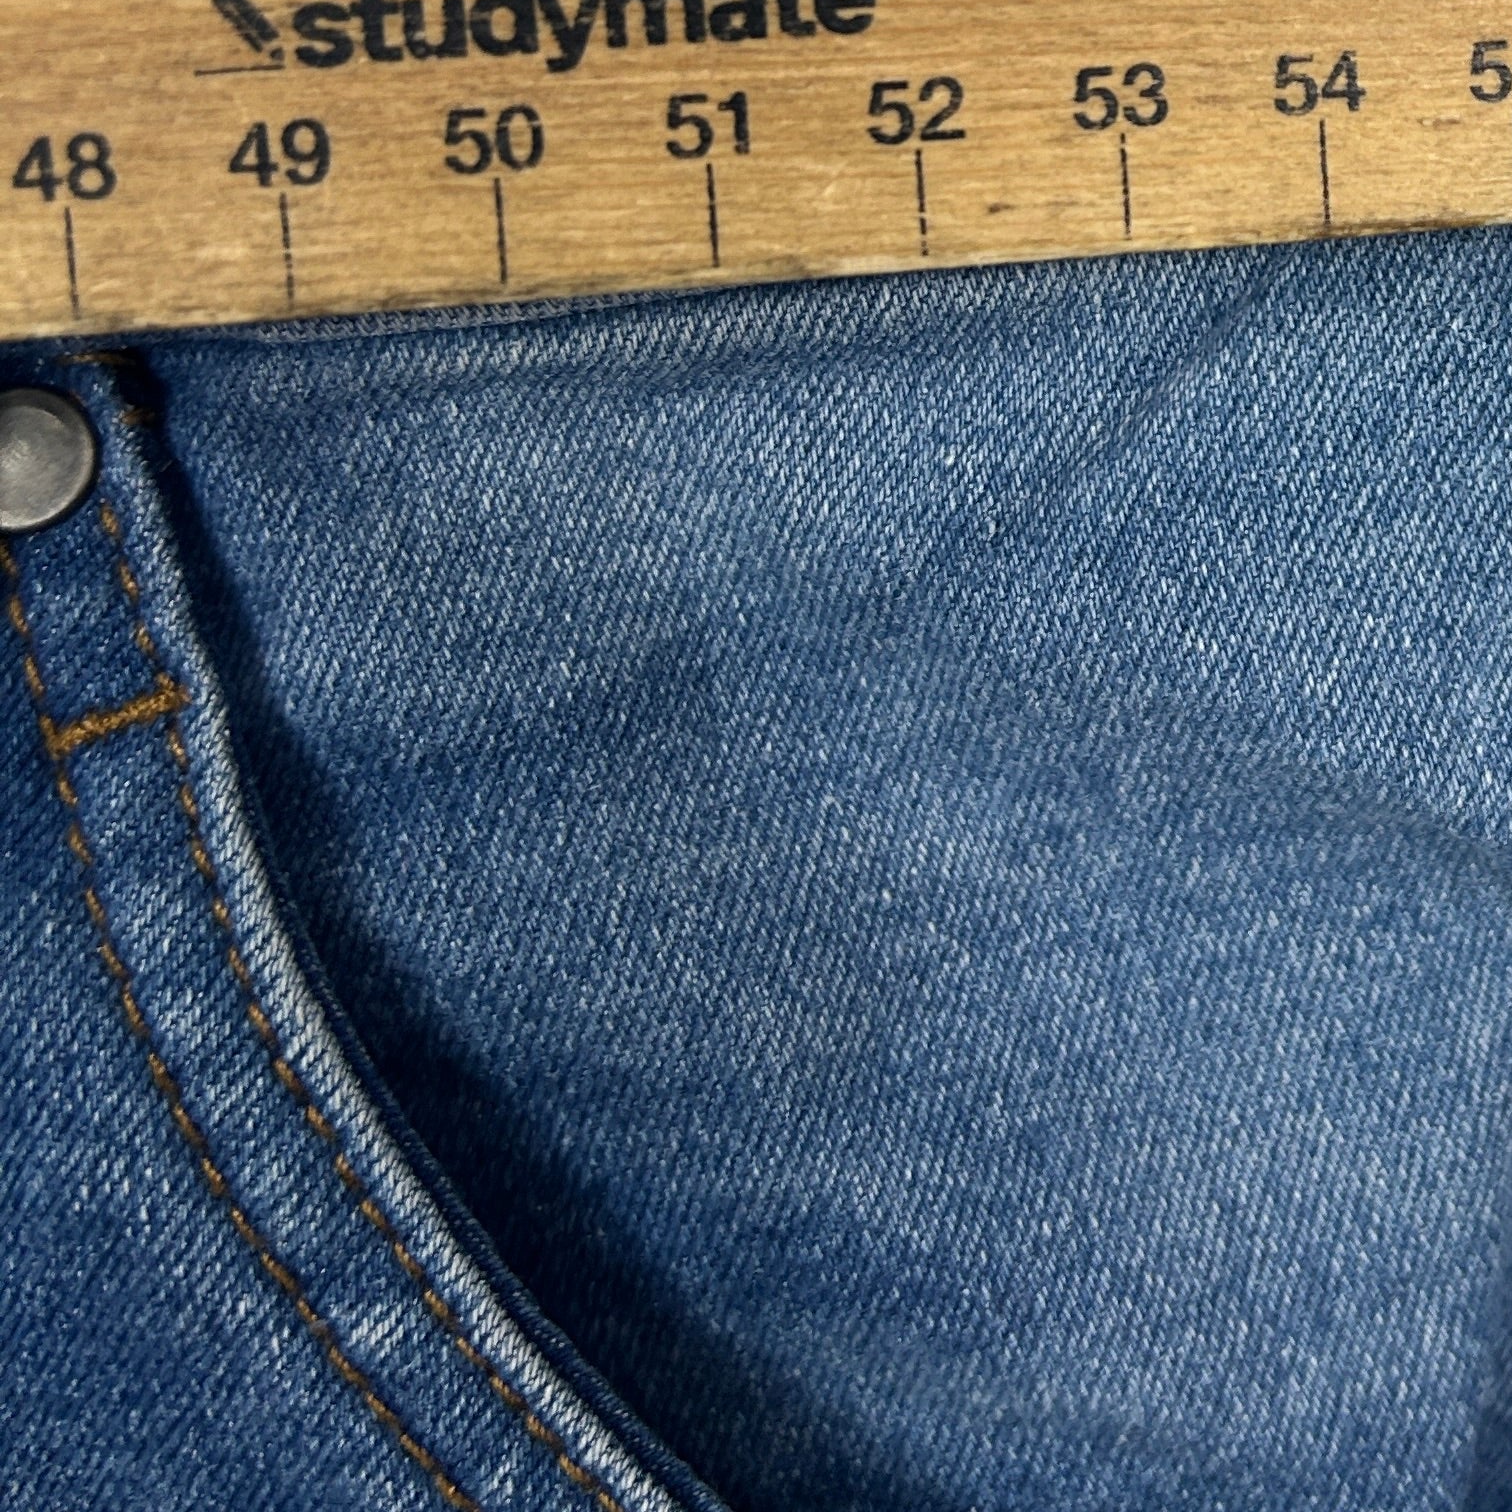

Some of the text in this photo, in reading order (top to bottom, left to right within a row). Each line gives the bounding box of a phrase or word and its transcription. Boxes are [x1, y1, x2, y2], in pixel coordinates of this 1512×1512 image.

[12, 133, 116, 202] 48
[228, 118, 330, 187] 49
[444, 105, 544, 175] 50
[666, 91, 750, 159] 51
[866, 76, 966, 145] 52
[1073, 63, 1168, 131] 53
[1274, 50, 1366, 116] 54
